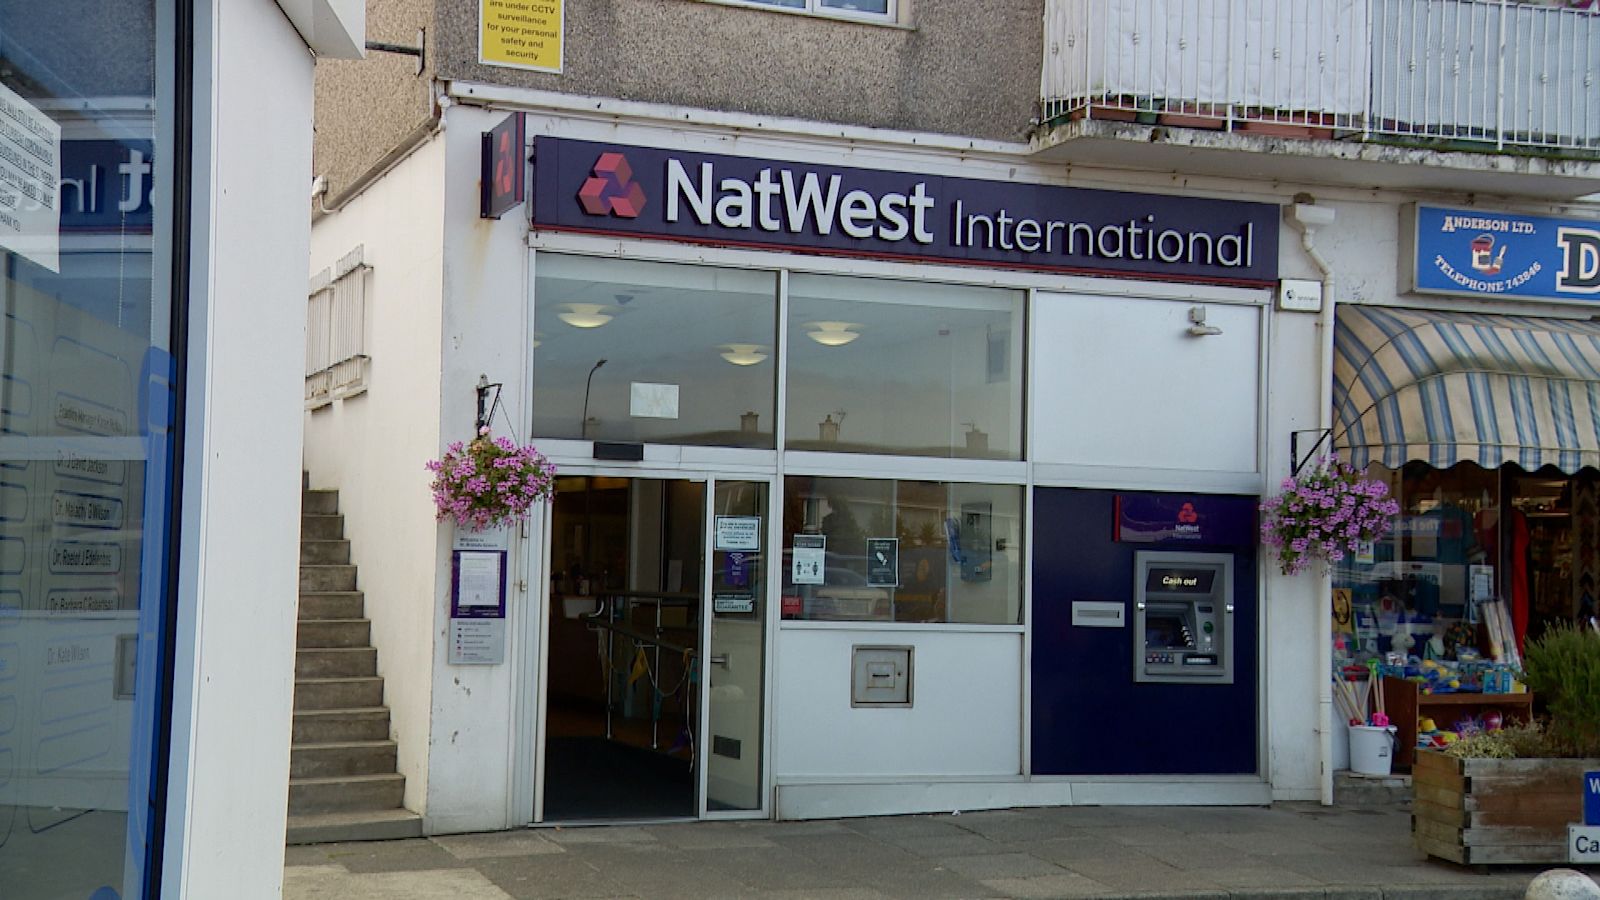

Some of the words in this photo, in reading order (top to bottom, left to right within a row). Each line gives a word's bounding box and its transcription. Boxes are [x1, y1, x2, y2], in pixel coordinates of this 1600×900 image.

[505, 3, 529, 11] under
[531, 5, 555, 14] CCTV
[498, 13, 547, 25] surveillance
[487, 22, 499, 31] for
[501, 25, 520, 33] your
[521, 28, 558, 39] personal
[501, 37, 526, 47] safety
[505, 50, 539, 60] security
[665, 158, 934, 245] NatWest
[954, 200, 1254, 267] International
[1441, 216, 1509, 233] ANDERSON
[1511, 221, 1537, 235] LTD.
[1555, 226, 1600, 294] D
[1434, 254, 1505, 293] TELEPHONE
[1506, 261, 1541, 290] 743846
[1162, 575, 1182, 586] Cash
[1183, 577, 1197, 586] out
[1575, 835, 1600, 854] Ca
